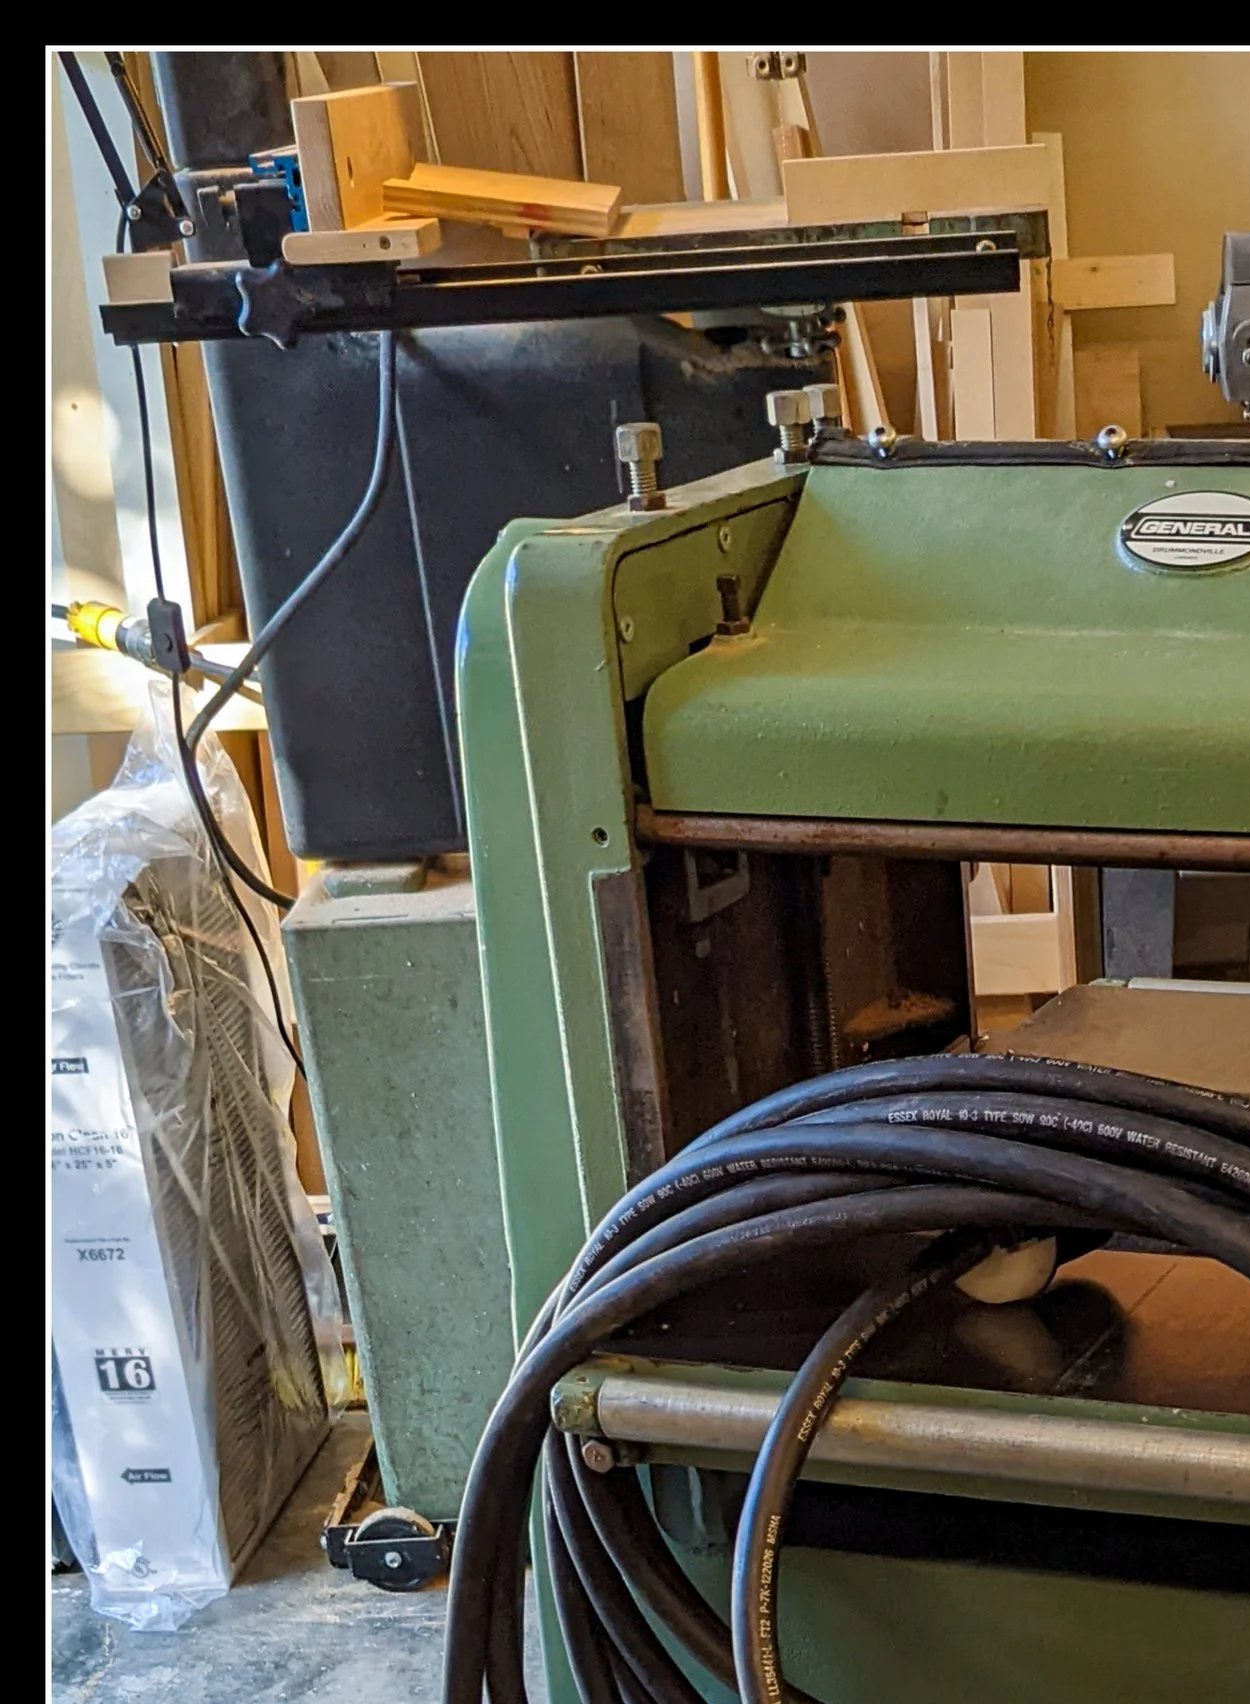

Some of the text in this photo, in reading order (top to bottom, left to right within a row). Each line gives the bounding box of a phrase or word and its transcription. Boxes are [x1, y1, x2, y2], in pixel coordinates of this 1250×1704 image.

[1152, 547, 1225, 555] DRUMMONDVILLE
[888, 1110, 917, 1124] ESSEX
[922, 1108, 953, 1122] ROYAL
[958, 1110, 978, 1122] 10-3
[984, 1111, 1008, 1123] TYPE
[1012, 1112, 1034, 1125] SOW
[1097, 1123, 1122, 1139] 600V
[1127, 1130, 1161, 1148] WATER
[1165, 1141, 1217, 1168] RESISTANT
[637, 1194, 656, 1211] SOW
[657, 1184, 674, 1199] 90C
[726, 1159, 758, 1174] WATER
[77, 1248, 126, 1261] X6672
[96, 1348, 147, 1356] MERV
[100, 1359, 151, 1389] 16
[128, 1472, 168, 1480] Air Flow
[768, 1515, 781, 1545] MSHA
[760, 1548, 775, 1616] P-7K-122026
[760, 1619, 772, 1639] FT2
[762, 1641, 781, 1702] LL35441-L
